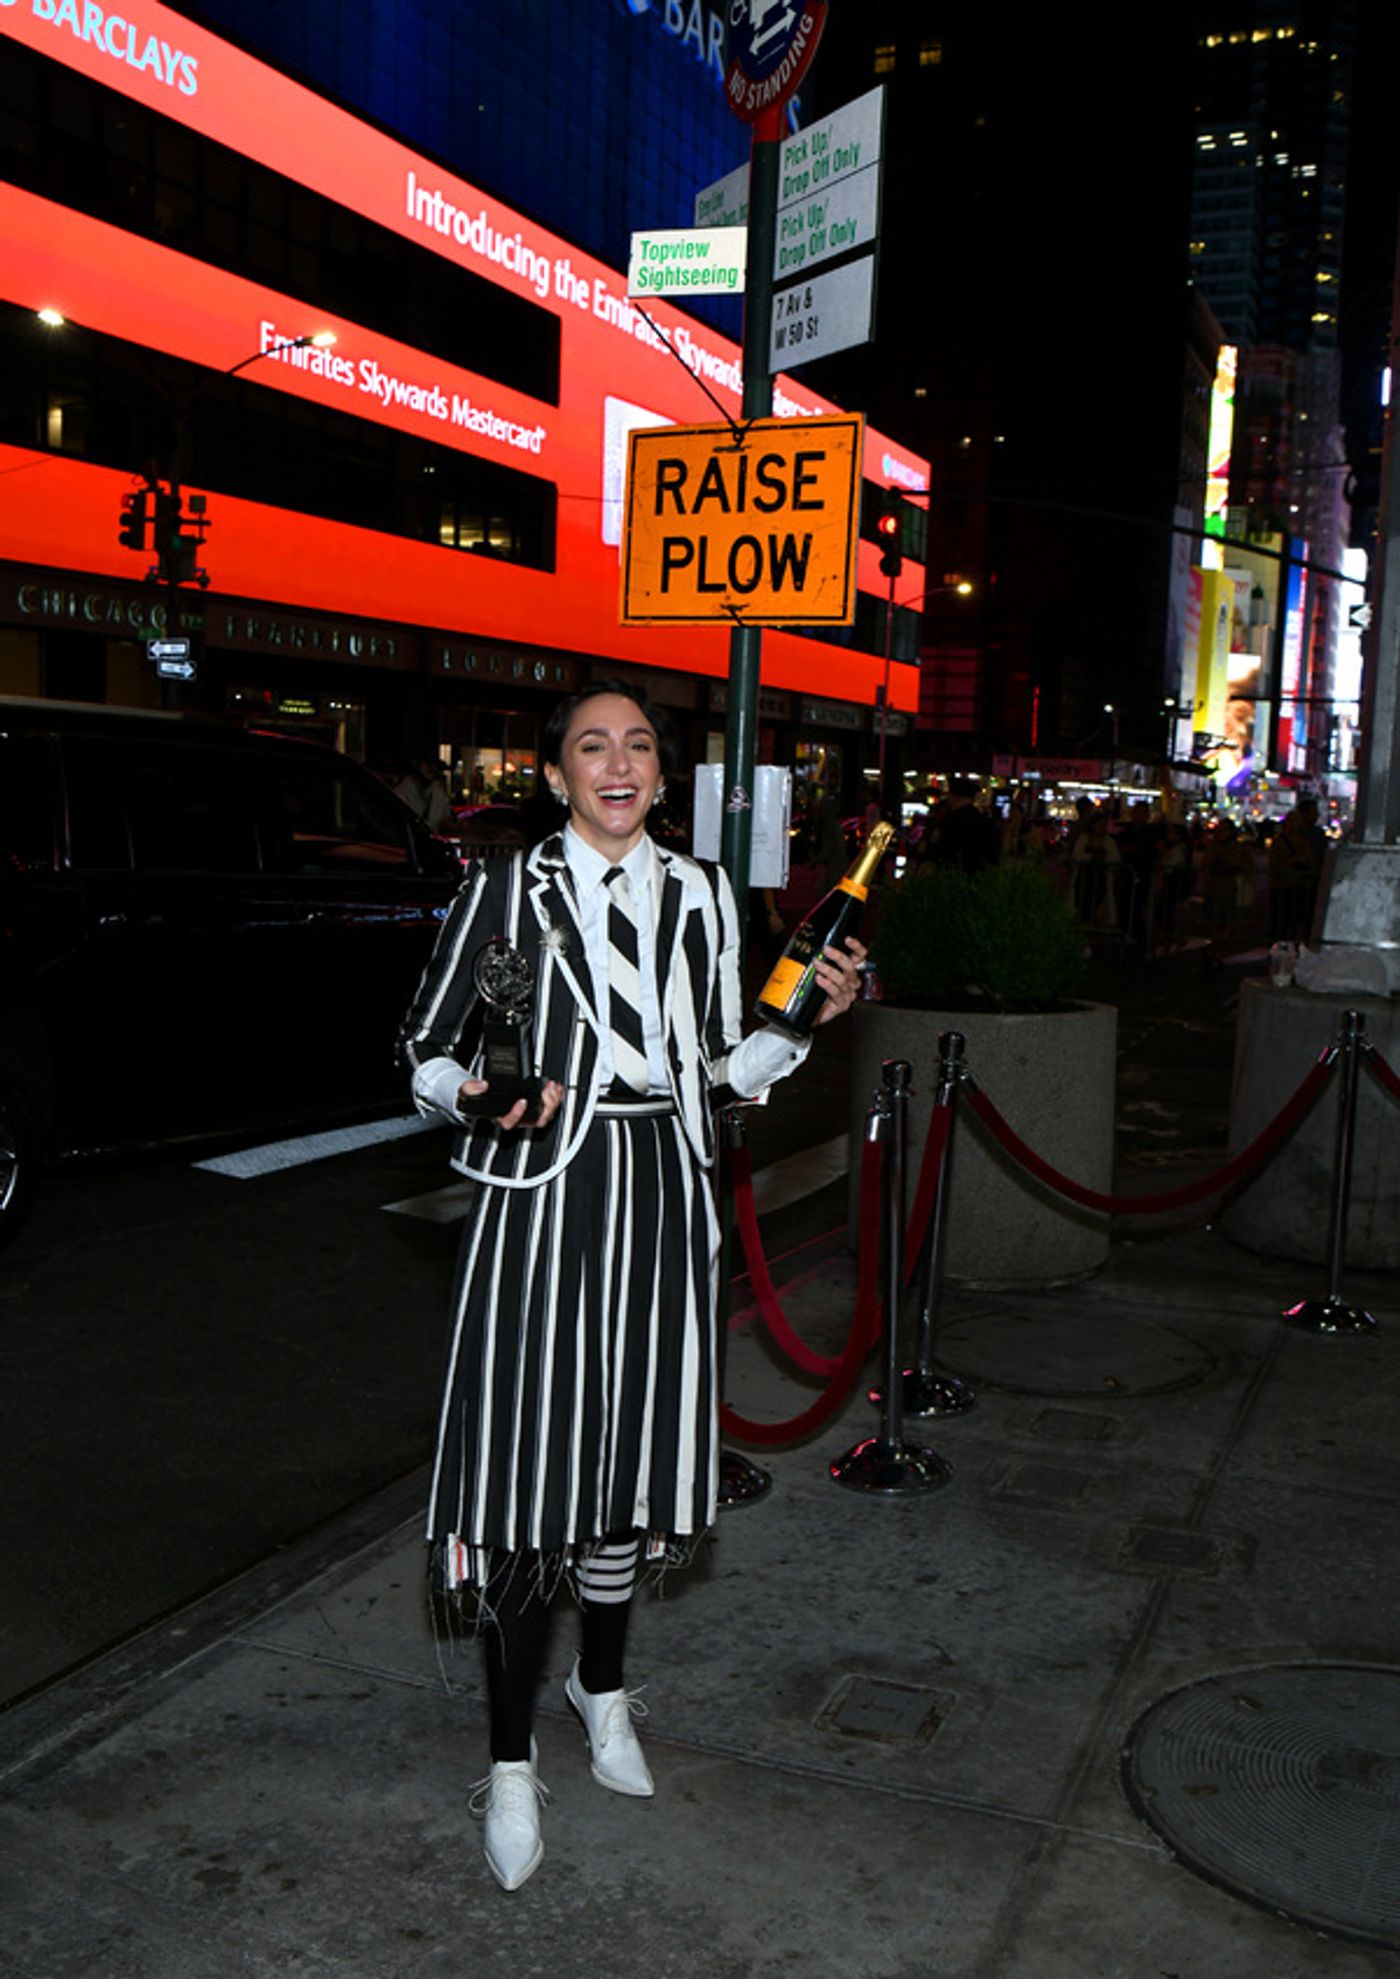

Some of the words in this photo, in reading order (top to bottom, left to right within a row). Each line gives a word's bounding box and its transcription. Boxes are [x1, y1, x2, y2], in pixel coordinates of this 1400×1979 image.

[728, 68, 746, 104] NO
[747, 14, 814, 109] STANDING
[782, 170, 809, 199] Drop
[812, 155, 830, 183] Off
[833, 141, 860, 172] Only
[784, 139, 808, 170] Pick
[779, 243, 806, 270] Drop
[809, 228, 827, 256] Off
[829, 216, 857, 247] Only
[781, 211, 804, 241] Pick
[406, 171, 549, 298] Introducing
[554, 258, 589, 309] the
[593, 278, 672, 355] Emirates
[639, 238, 711, 265] Topview
[637, 264, 739, 291] Sightseeing
[776, 298, 784, 320] 7
[786, 294, 800, 317] Av
[804, 287, 813, 309] &
[789, 321, 804, 346] 50
[807, 315, 819, 340] St
[260, 321, 355, 386] Emirates
[358, 359, 449, 420] Skywards
[654, 450, 826, 516] RAISE
[660, 533, 813, 594] PLOW
[17, 583, 168, 628] CHICAGO
[225, 614, 398, 659] FRANKFURT
